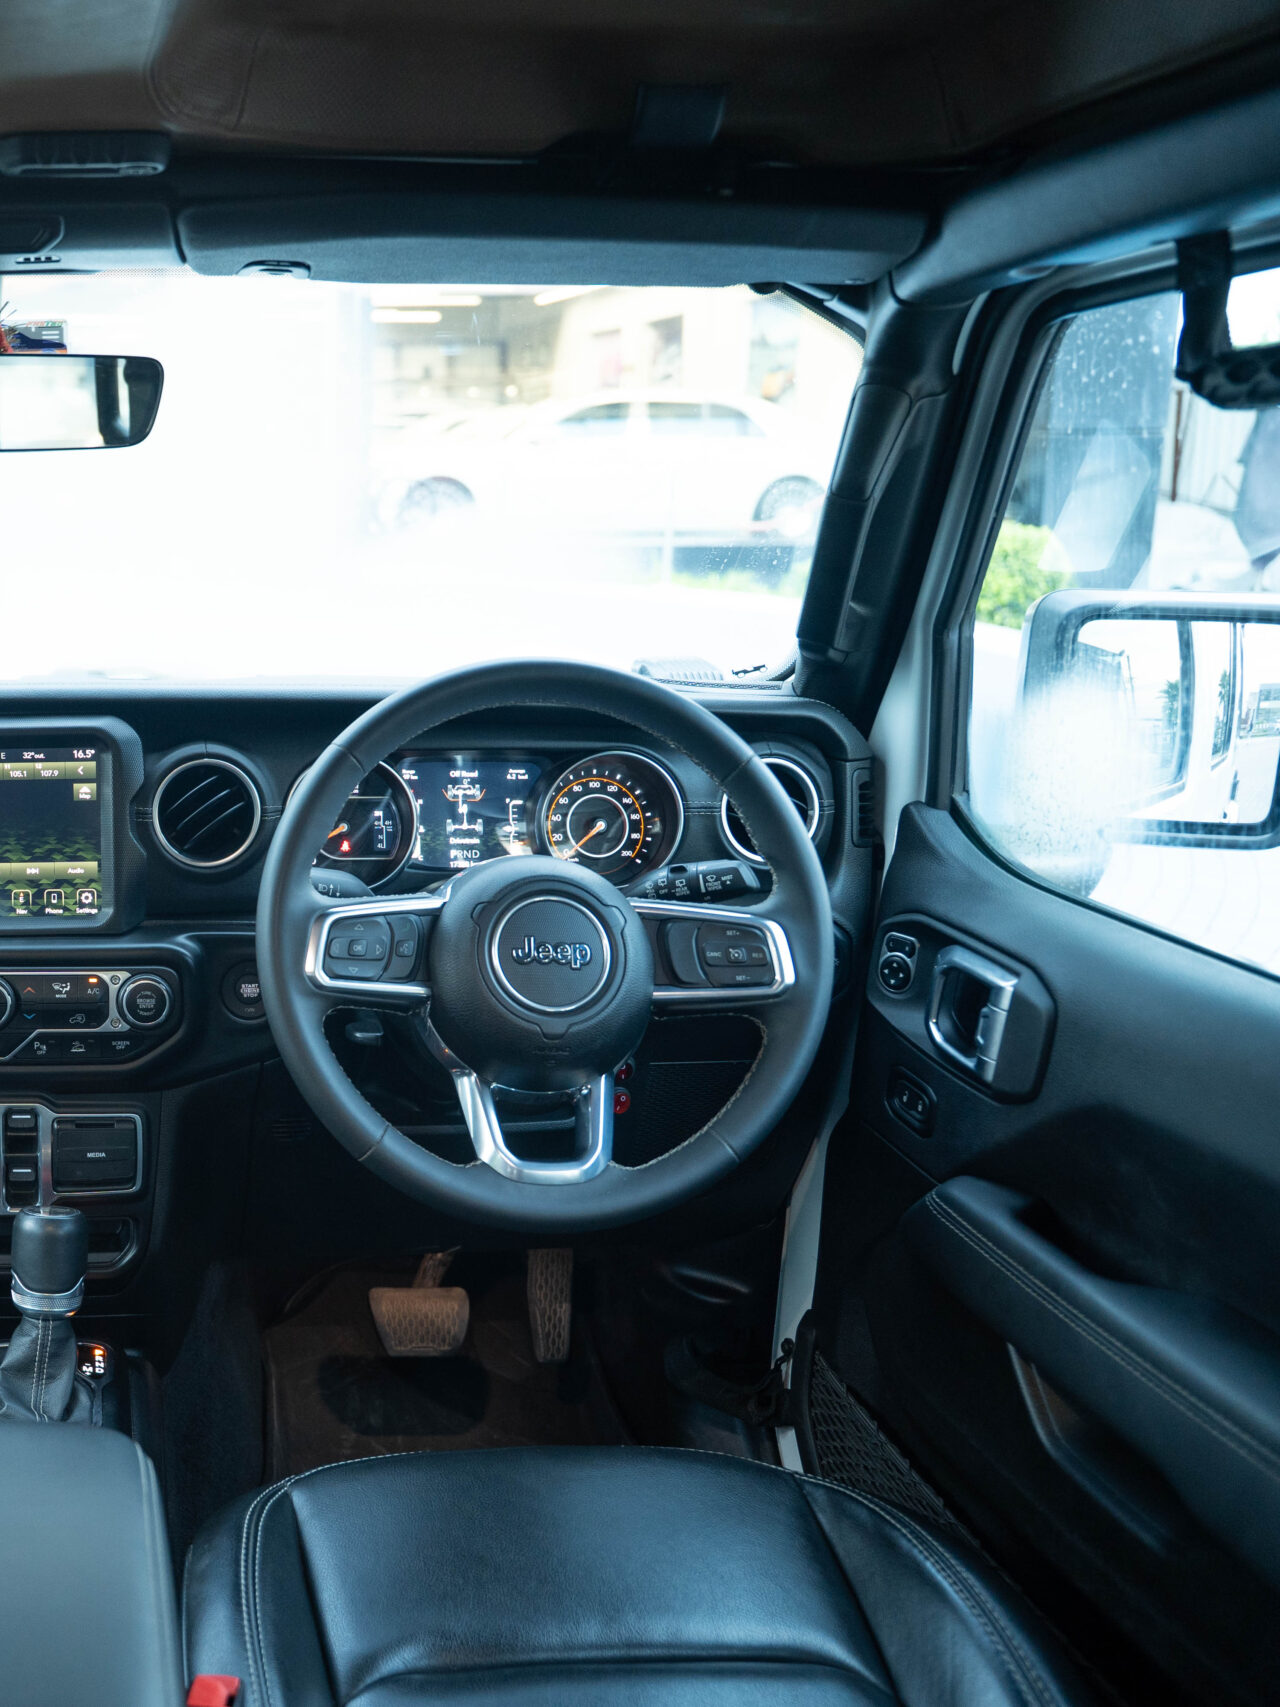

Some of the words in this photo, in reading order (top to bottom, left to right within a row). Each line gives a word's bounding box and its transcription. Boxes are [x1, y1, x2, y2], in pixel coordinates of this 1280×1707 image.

[73, 749, 95, 759] 16.5°
[461, 770, 479, 778] Road
[552, 833, 563, 841] 20
[512, 935, 592, 969] Jeep
